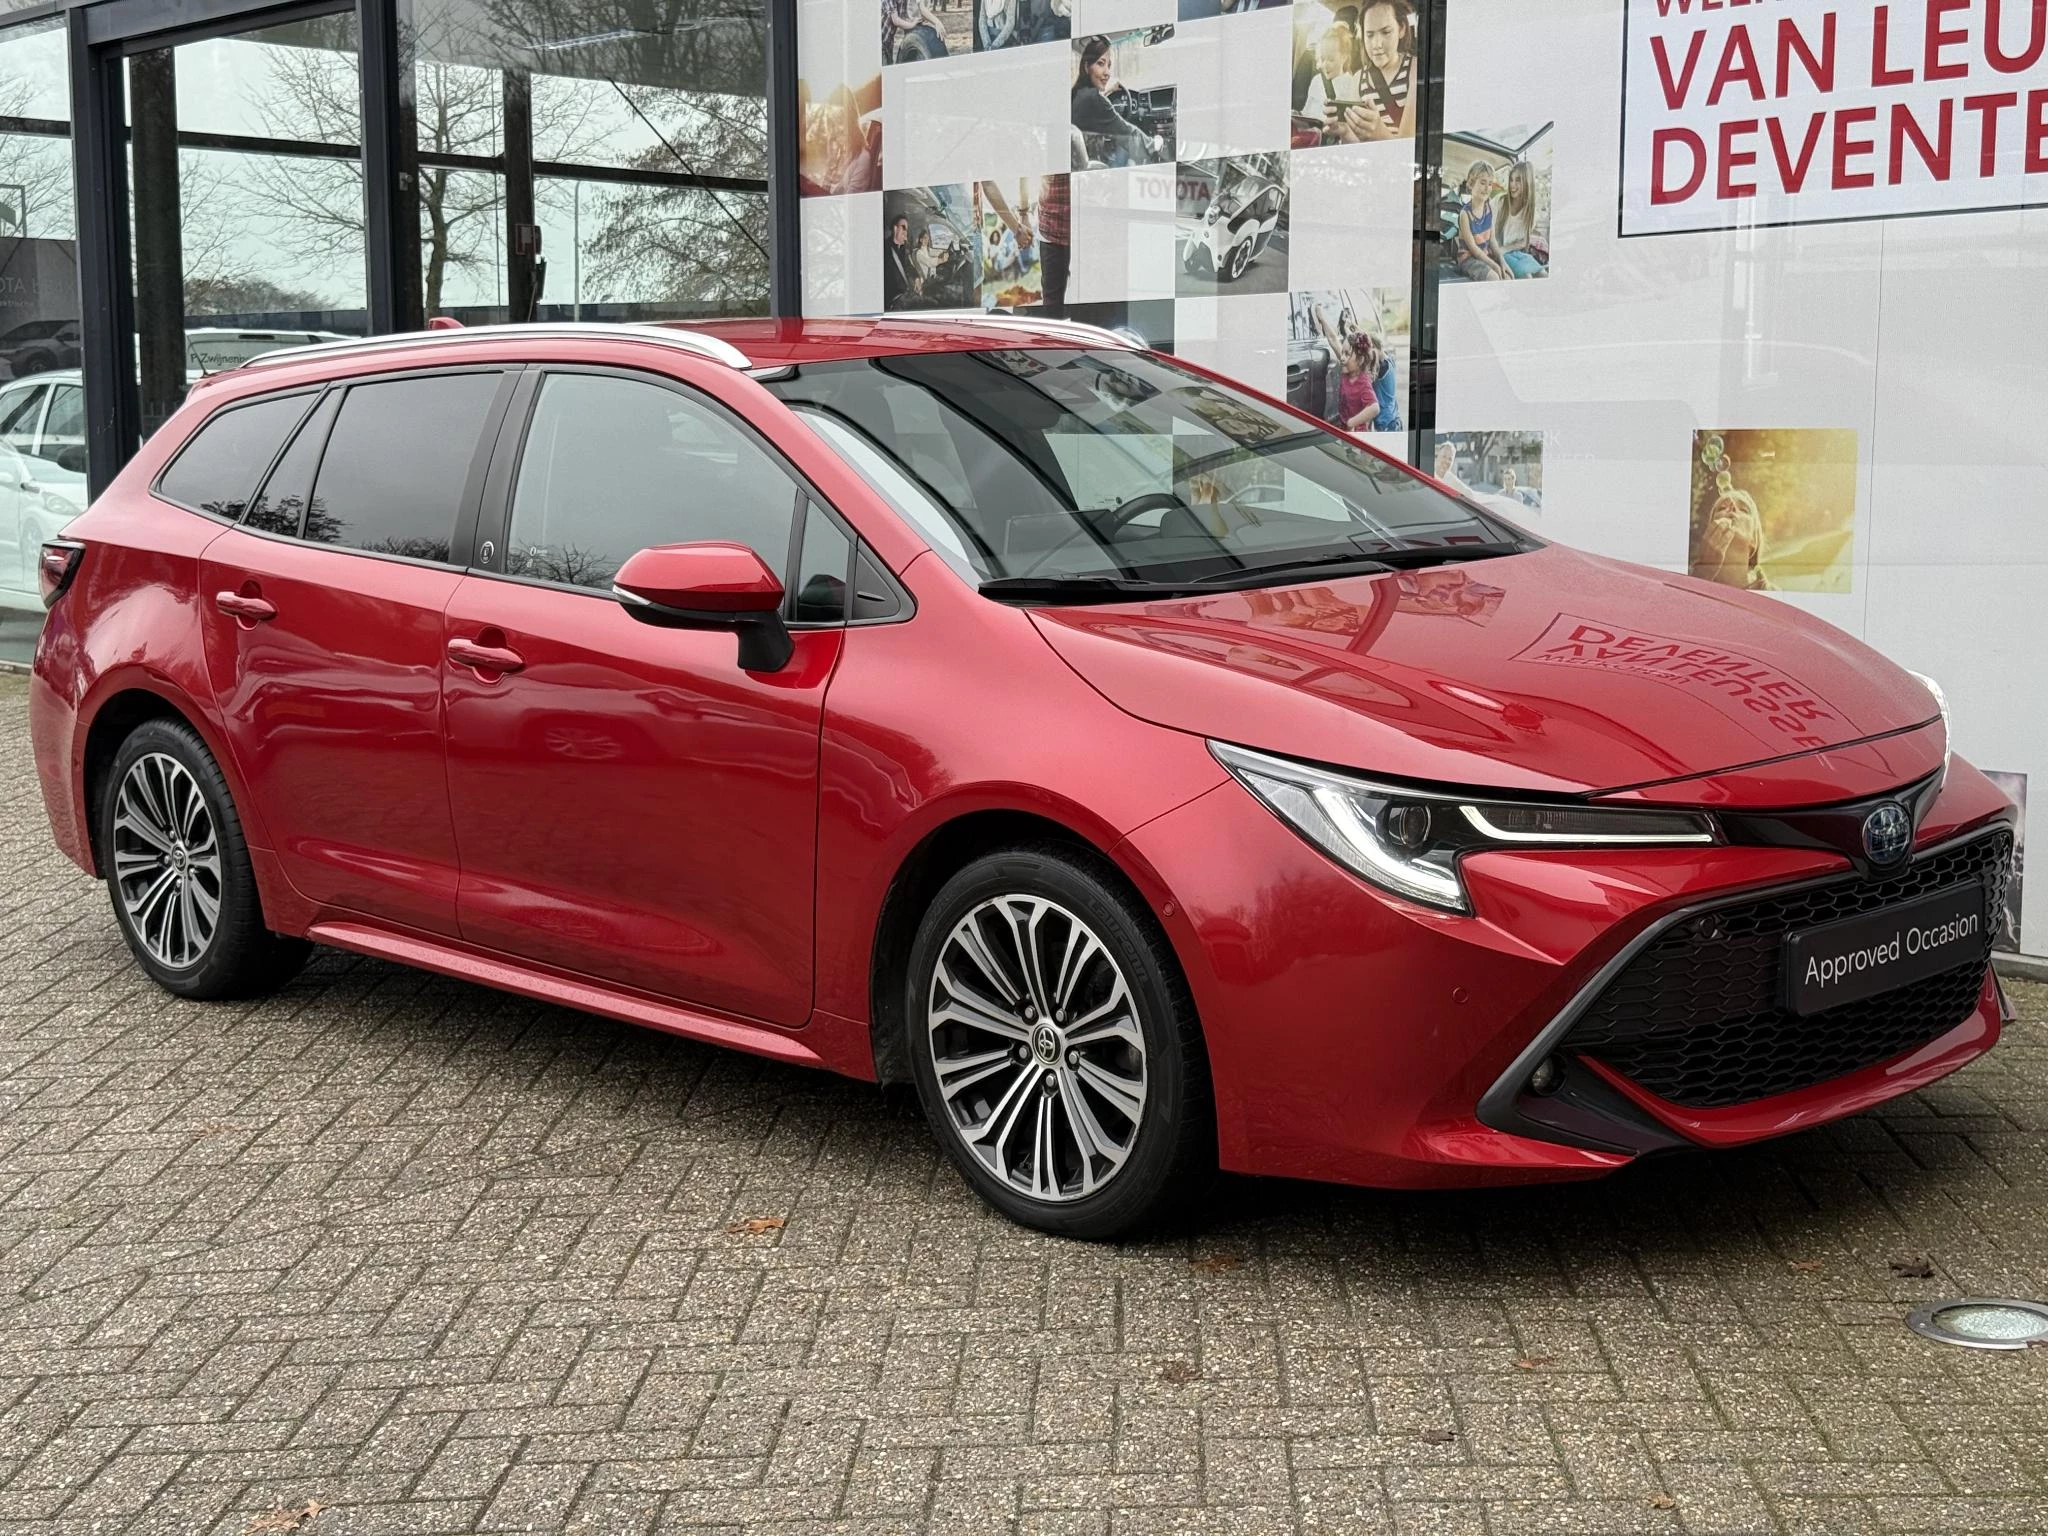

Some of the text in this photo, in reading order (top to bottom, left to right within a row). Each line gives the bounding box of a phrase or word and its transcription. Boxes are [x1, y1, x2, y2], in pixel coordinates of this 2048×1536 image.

[1650, 0, 2047, 110] VAN LEU
[1136, 176, 1211, 201] TOYOTA
[1805, 913, 1978, 988] Approved Occasion
